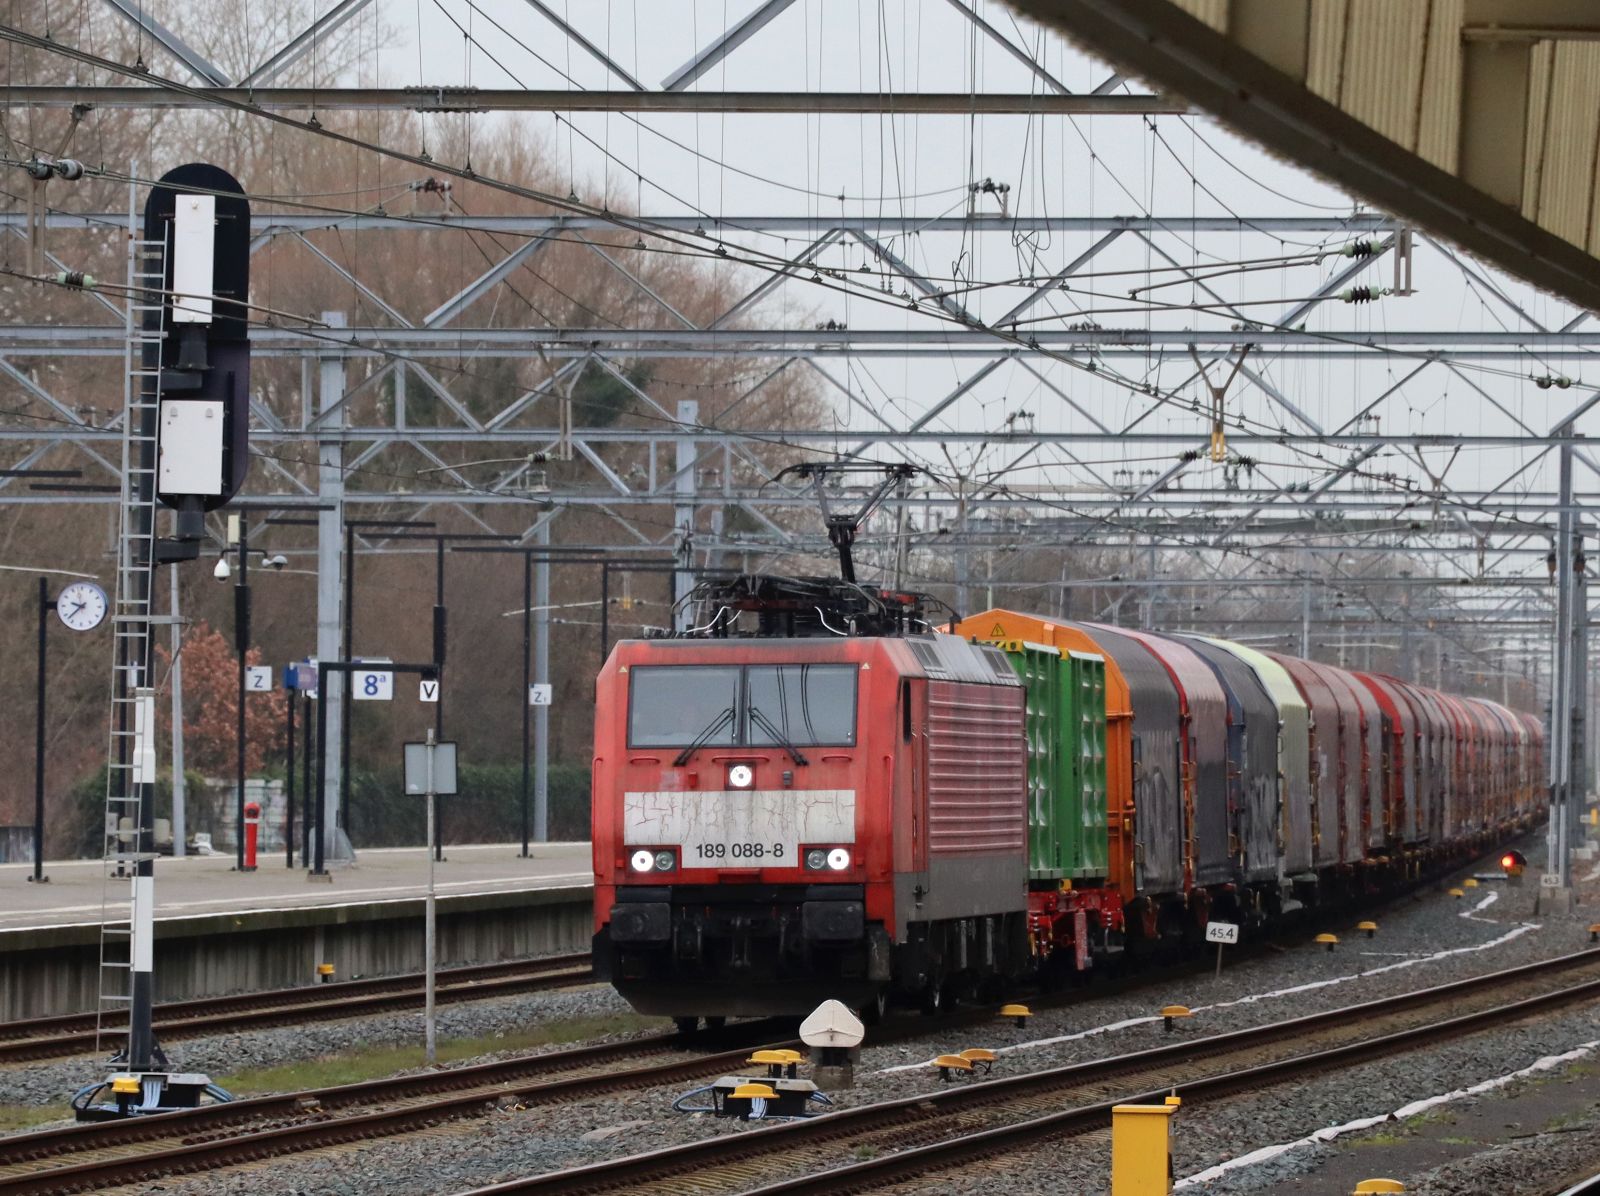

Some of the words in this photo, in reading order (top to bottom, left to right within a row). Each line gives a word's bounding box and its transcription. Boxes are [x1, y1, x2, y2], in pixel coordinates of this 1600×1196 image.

[254, 675, 263, 688] Z
[422, 682, 436, 699] V
[696, 843, 726, 858] 189
[731, 843, 784, 858] 088-8
